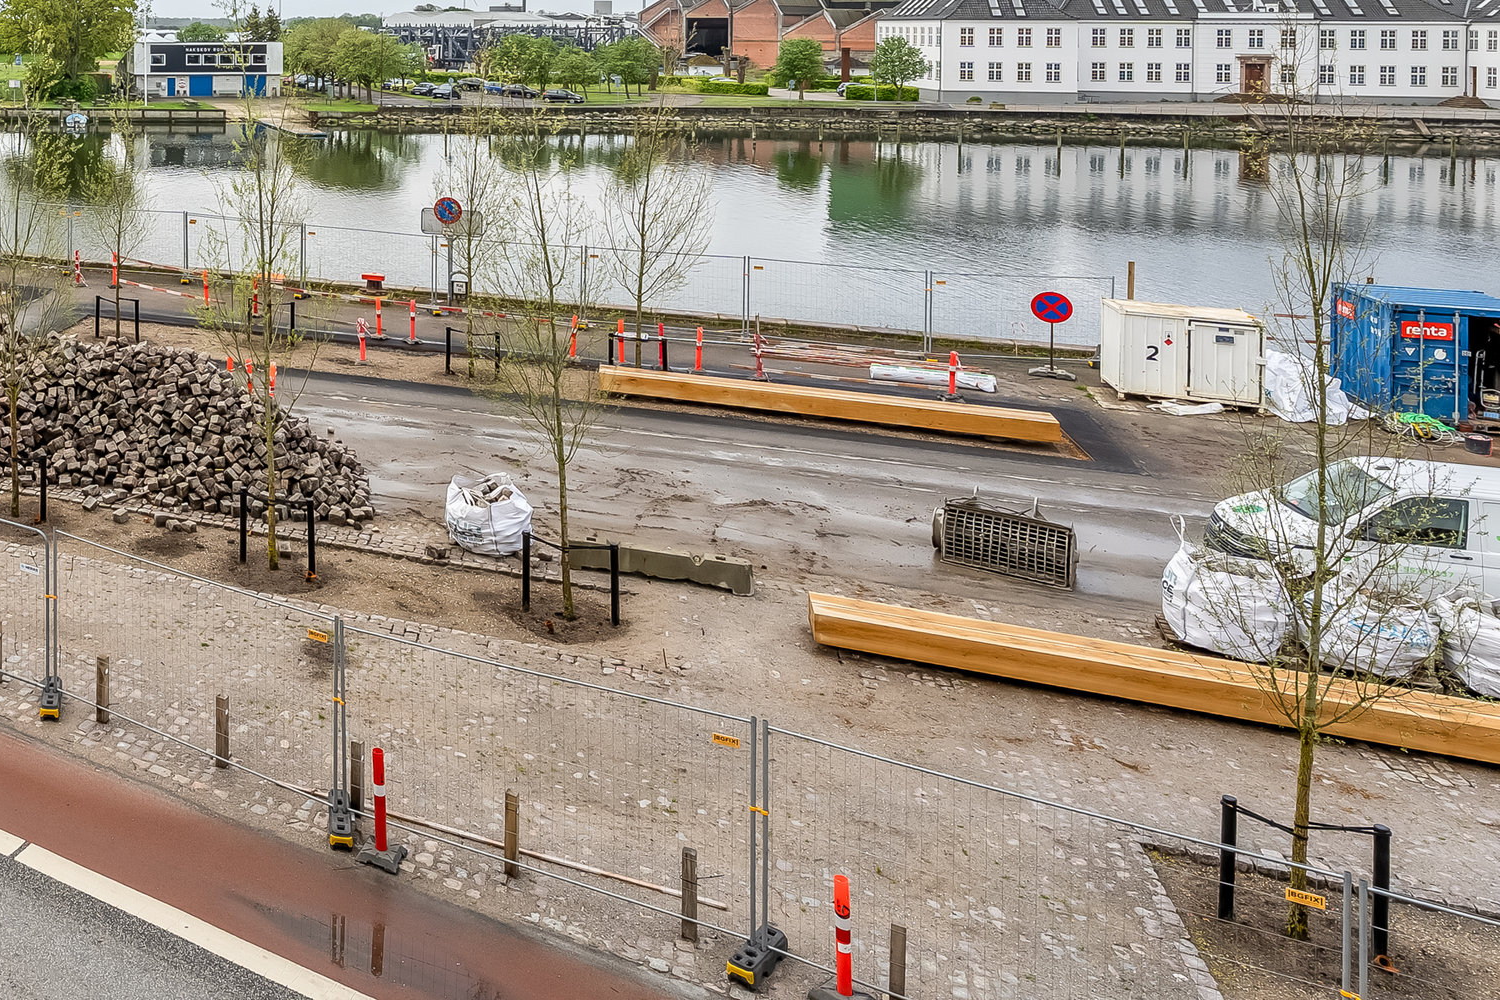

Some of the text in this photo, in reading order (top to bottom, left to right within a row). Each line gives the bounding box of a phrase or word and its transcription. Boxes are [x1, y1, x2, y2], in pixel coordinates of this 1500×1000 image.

[1406, 325, 1448, 338] renta
[1146, 345, 1160, 361] 2
[1290, 891, 1320, 904] BGFIX
